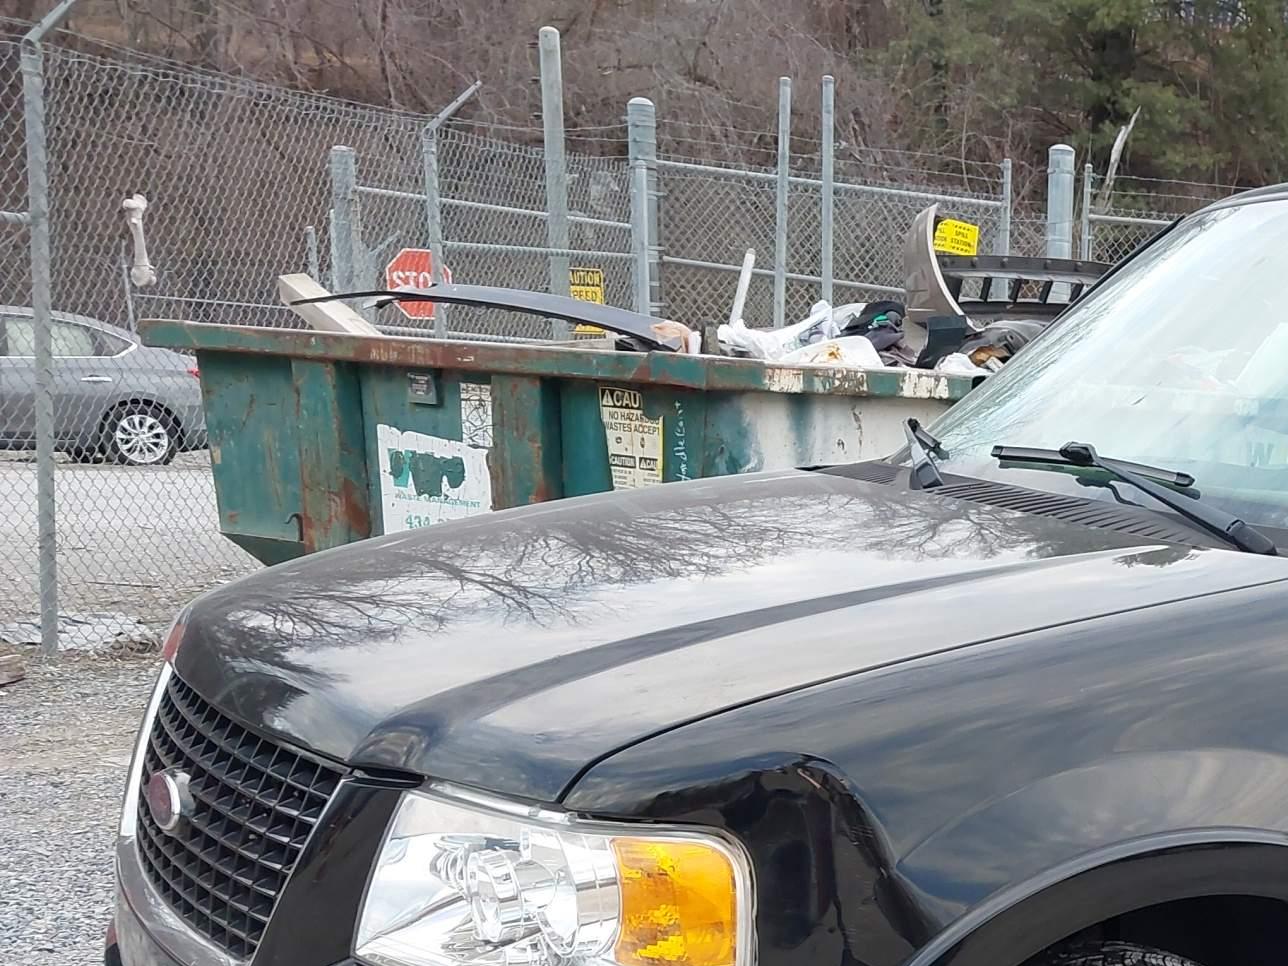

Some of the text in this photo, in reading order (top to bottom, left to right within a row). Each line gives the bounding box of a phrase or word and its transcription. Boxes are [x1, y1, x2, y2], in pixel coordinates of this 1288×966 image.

[570, 271, 601, 287] AUTION
[612, 390, 642, 409] CAU
[608, 410, 619, 421] NO
